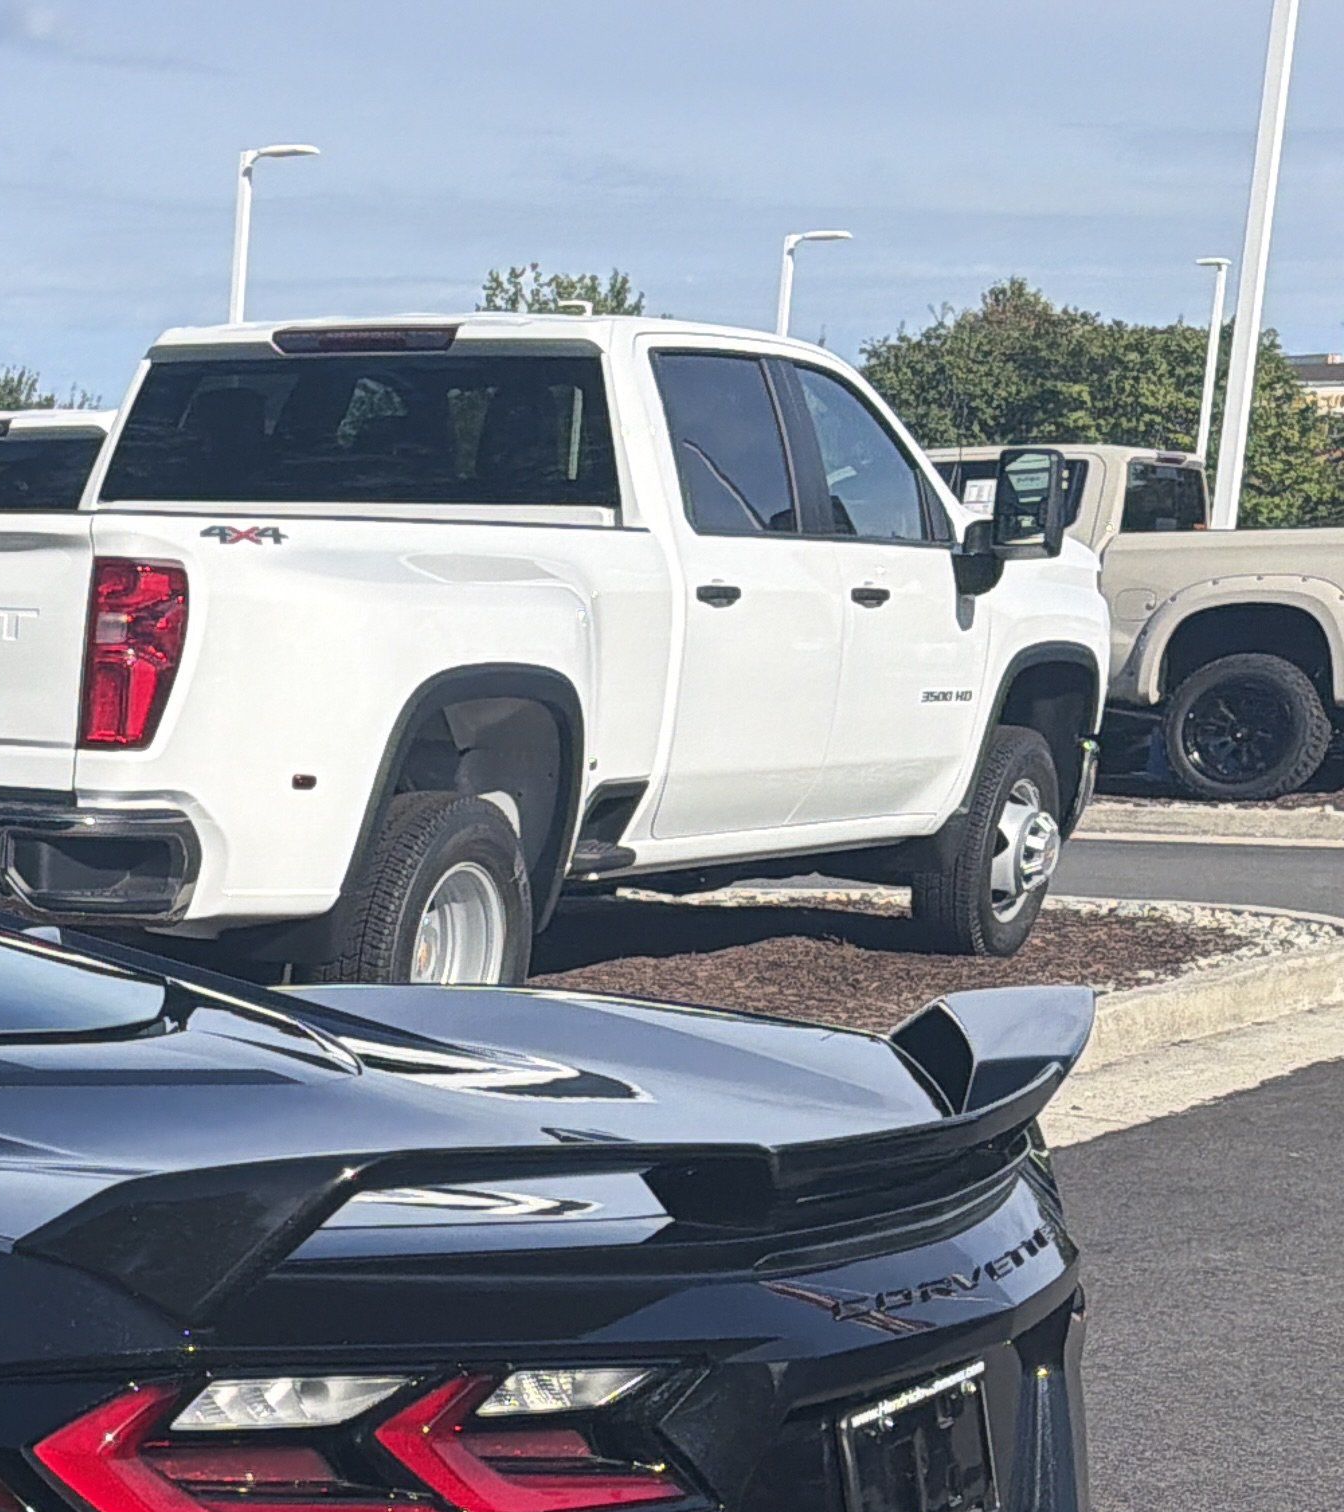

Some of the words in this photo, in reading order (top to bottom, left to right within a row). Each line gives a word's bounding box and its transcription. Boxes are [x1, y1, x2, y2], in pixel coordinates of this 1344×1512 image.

[921, 690, 953, 703] 3500
[955, 690, 973, 702] HD
[831, 1221, 1058, 1321] CORVETTE
